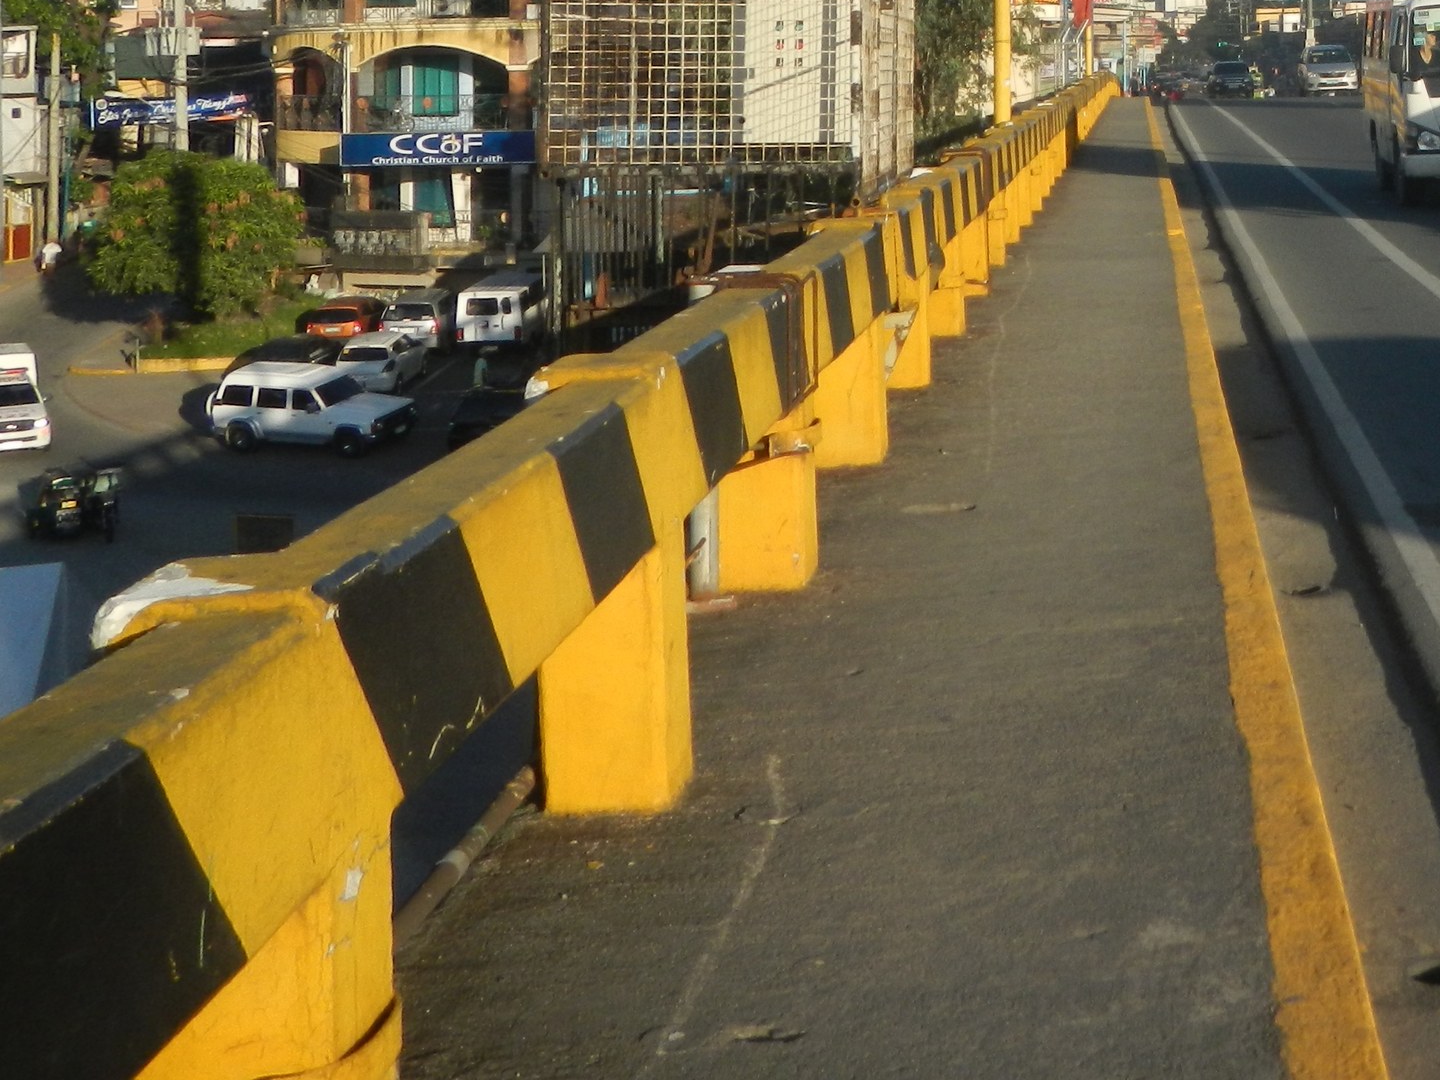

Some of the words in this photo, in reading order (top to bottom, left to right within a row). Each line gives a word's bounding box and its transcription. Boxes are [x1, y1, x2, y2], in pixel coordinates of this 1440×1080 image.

[372, 156, 419, 165] Christian
[421, 155, 459, 164] Church
[462, 155, 473, 163] of
[476, 155, 504, 163] Faith
